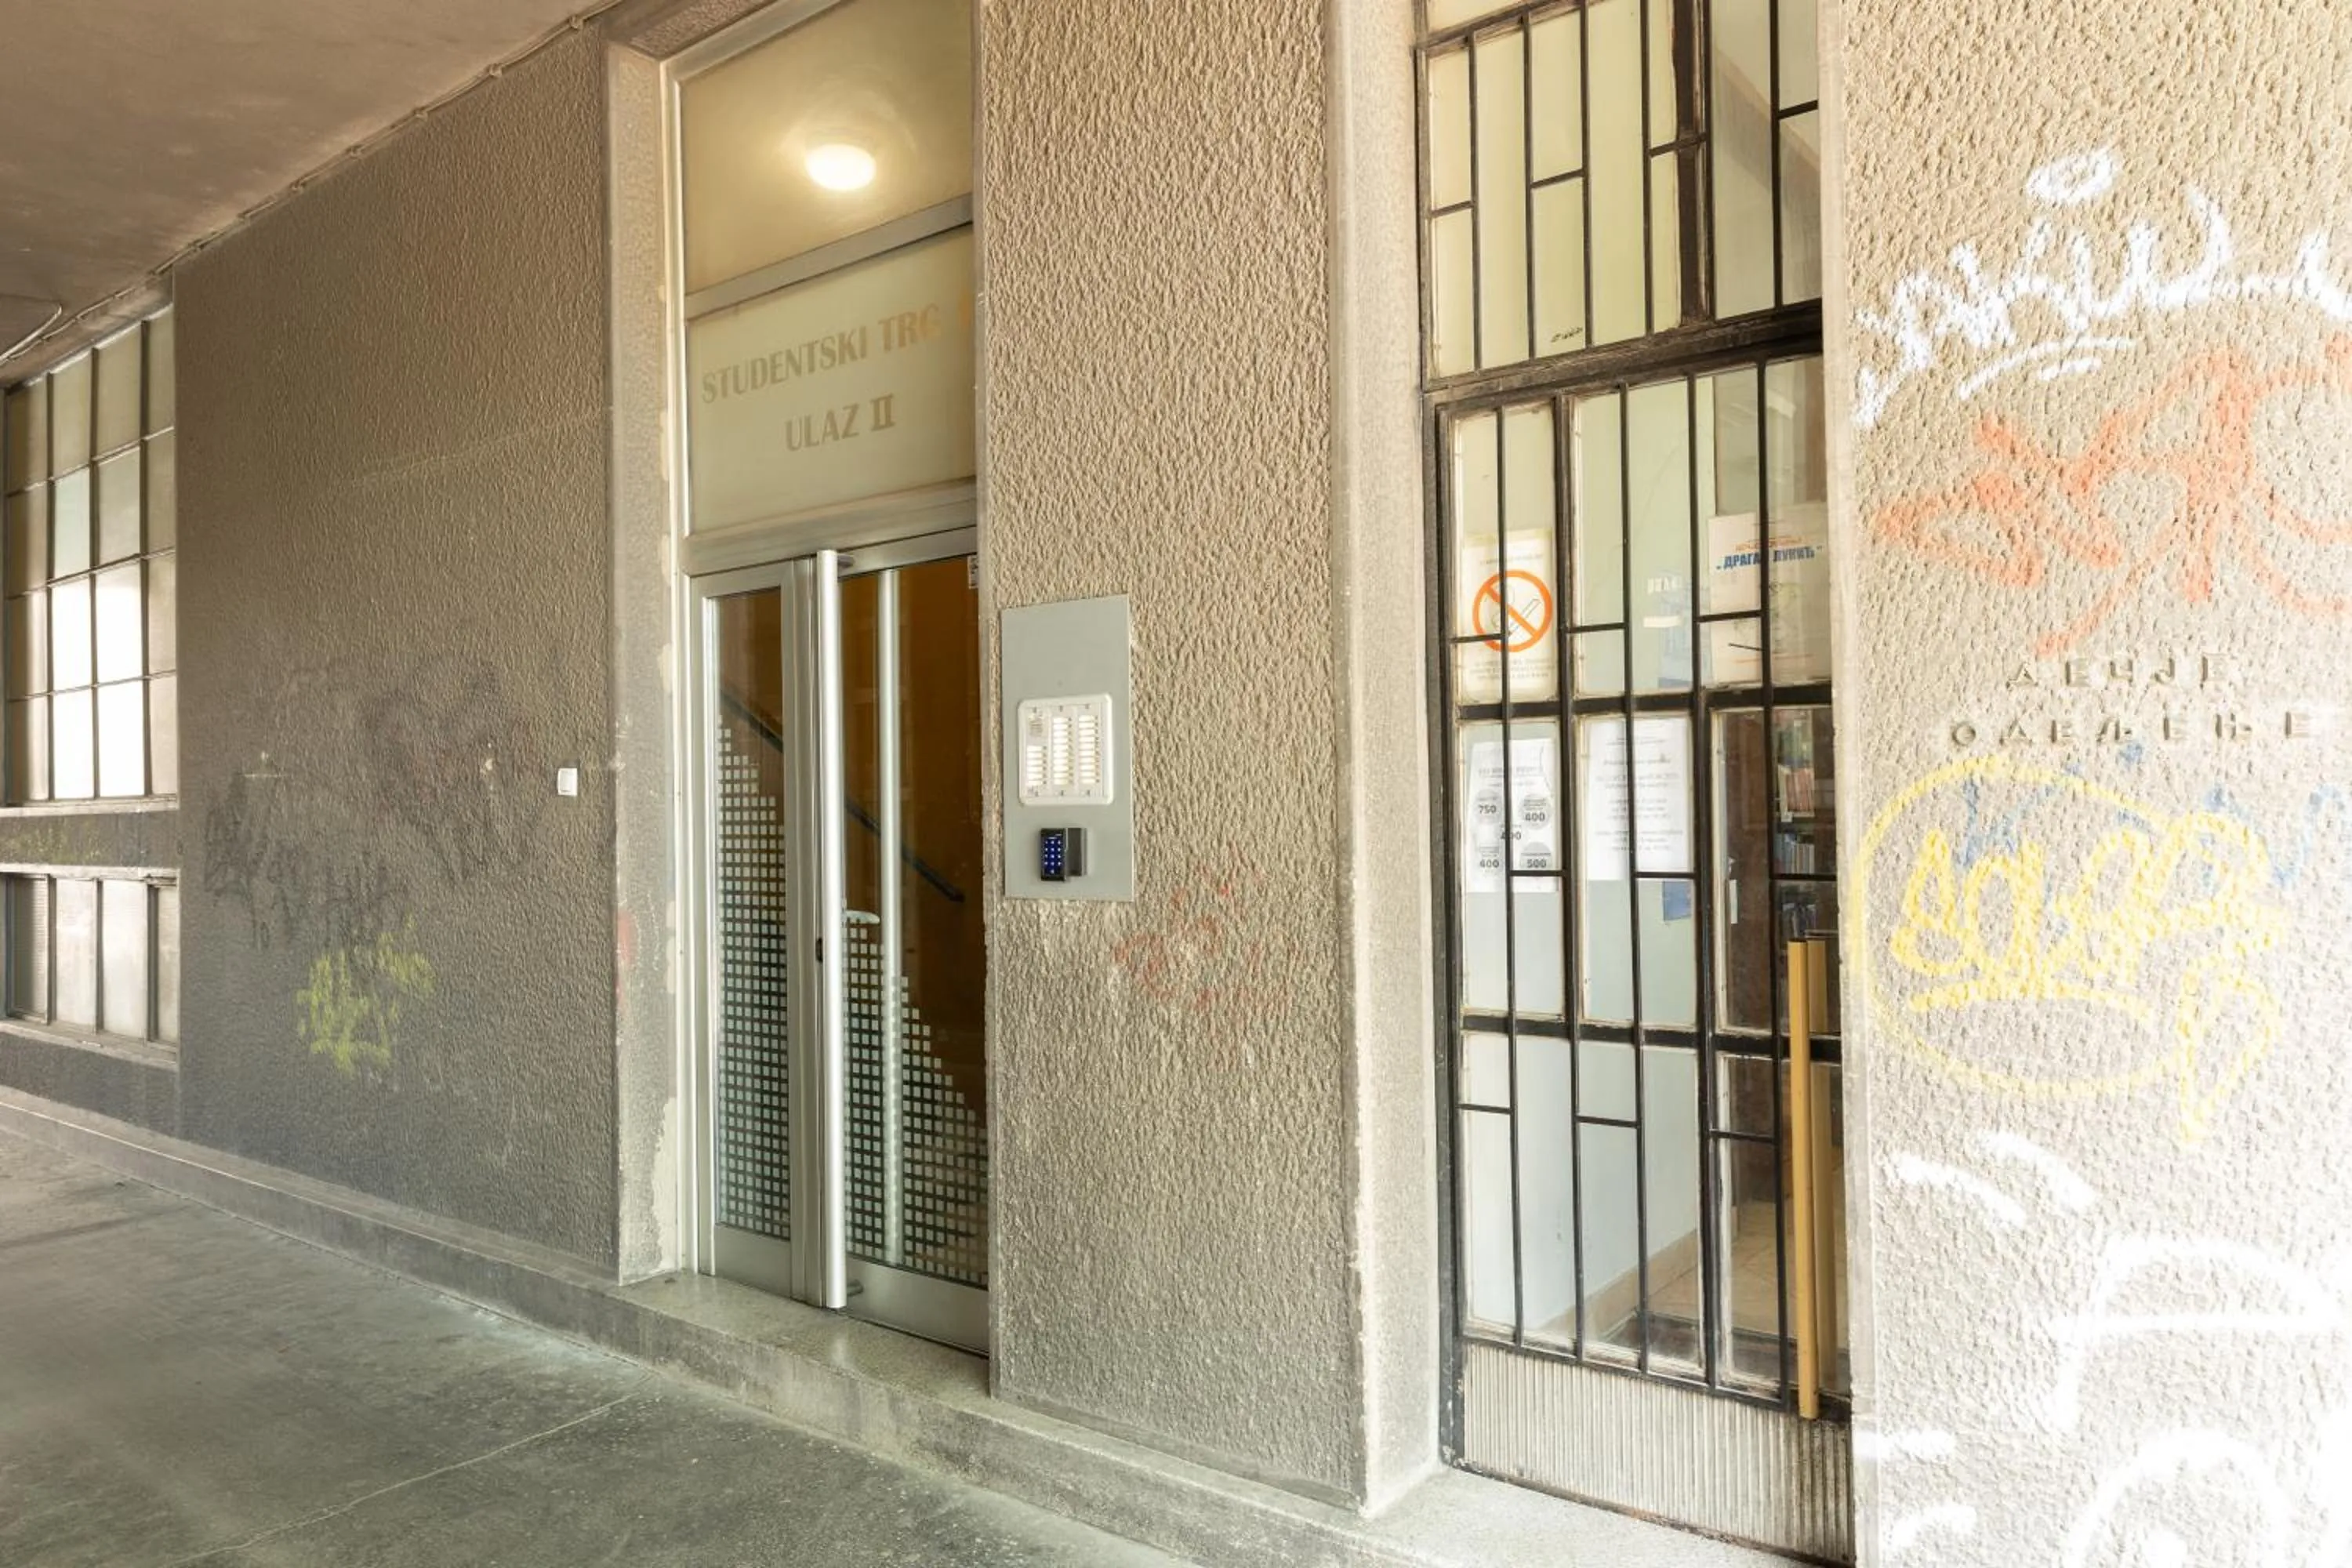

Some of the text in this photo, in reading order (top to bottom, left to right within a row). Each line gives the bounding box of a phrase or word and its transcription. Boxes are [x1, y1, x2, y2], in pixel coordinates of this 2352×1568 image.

[702, 325, 867, 404] STUDENTSKI
[785, 394, 896, 452] ULAZ II
